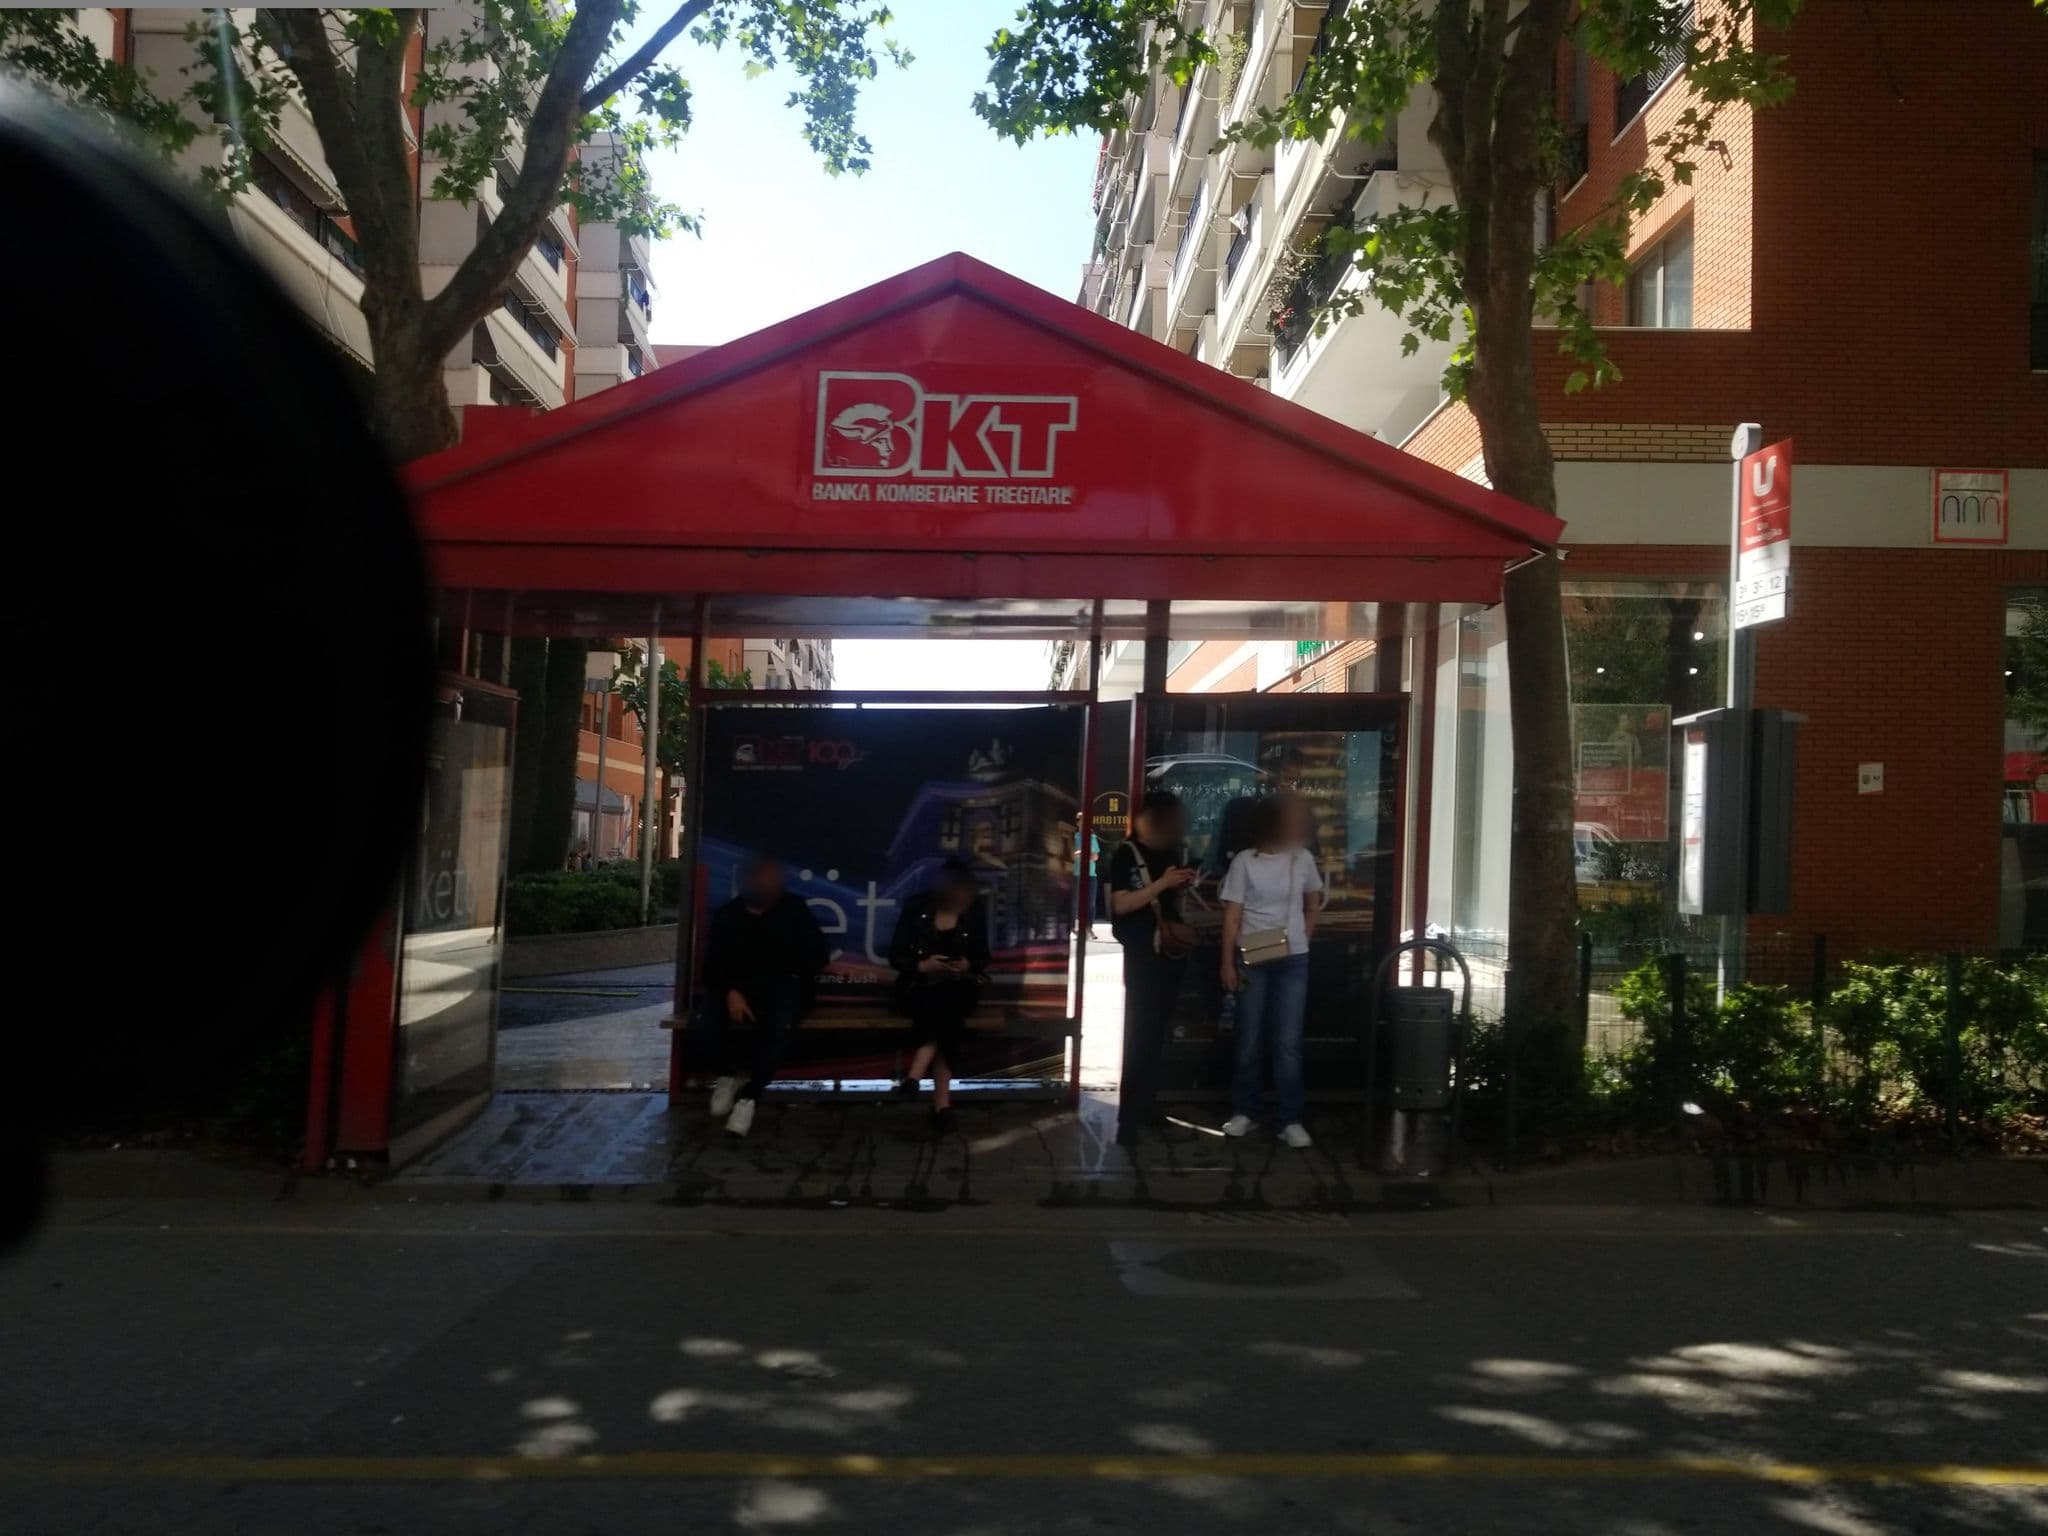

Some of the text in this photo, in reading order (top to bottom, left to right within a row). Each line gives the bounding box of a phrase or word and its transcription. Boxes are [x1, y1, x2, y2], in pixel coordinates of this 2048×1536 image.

[814, 371, 1078, 478] BKT
[812, 482, 1074, 505] BANKA KOMBETARE TREGTARE
